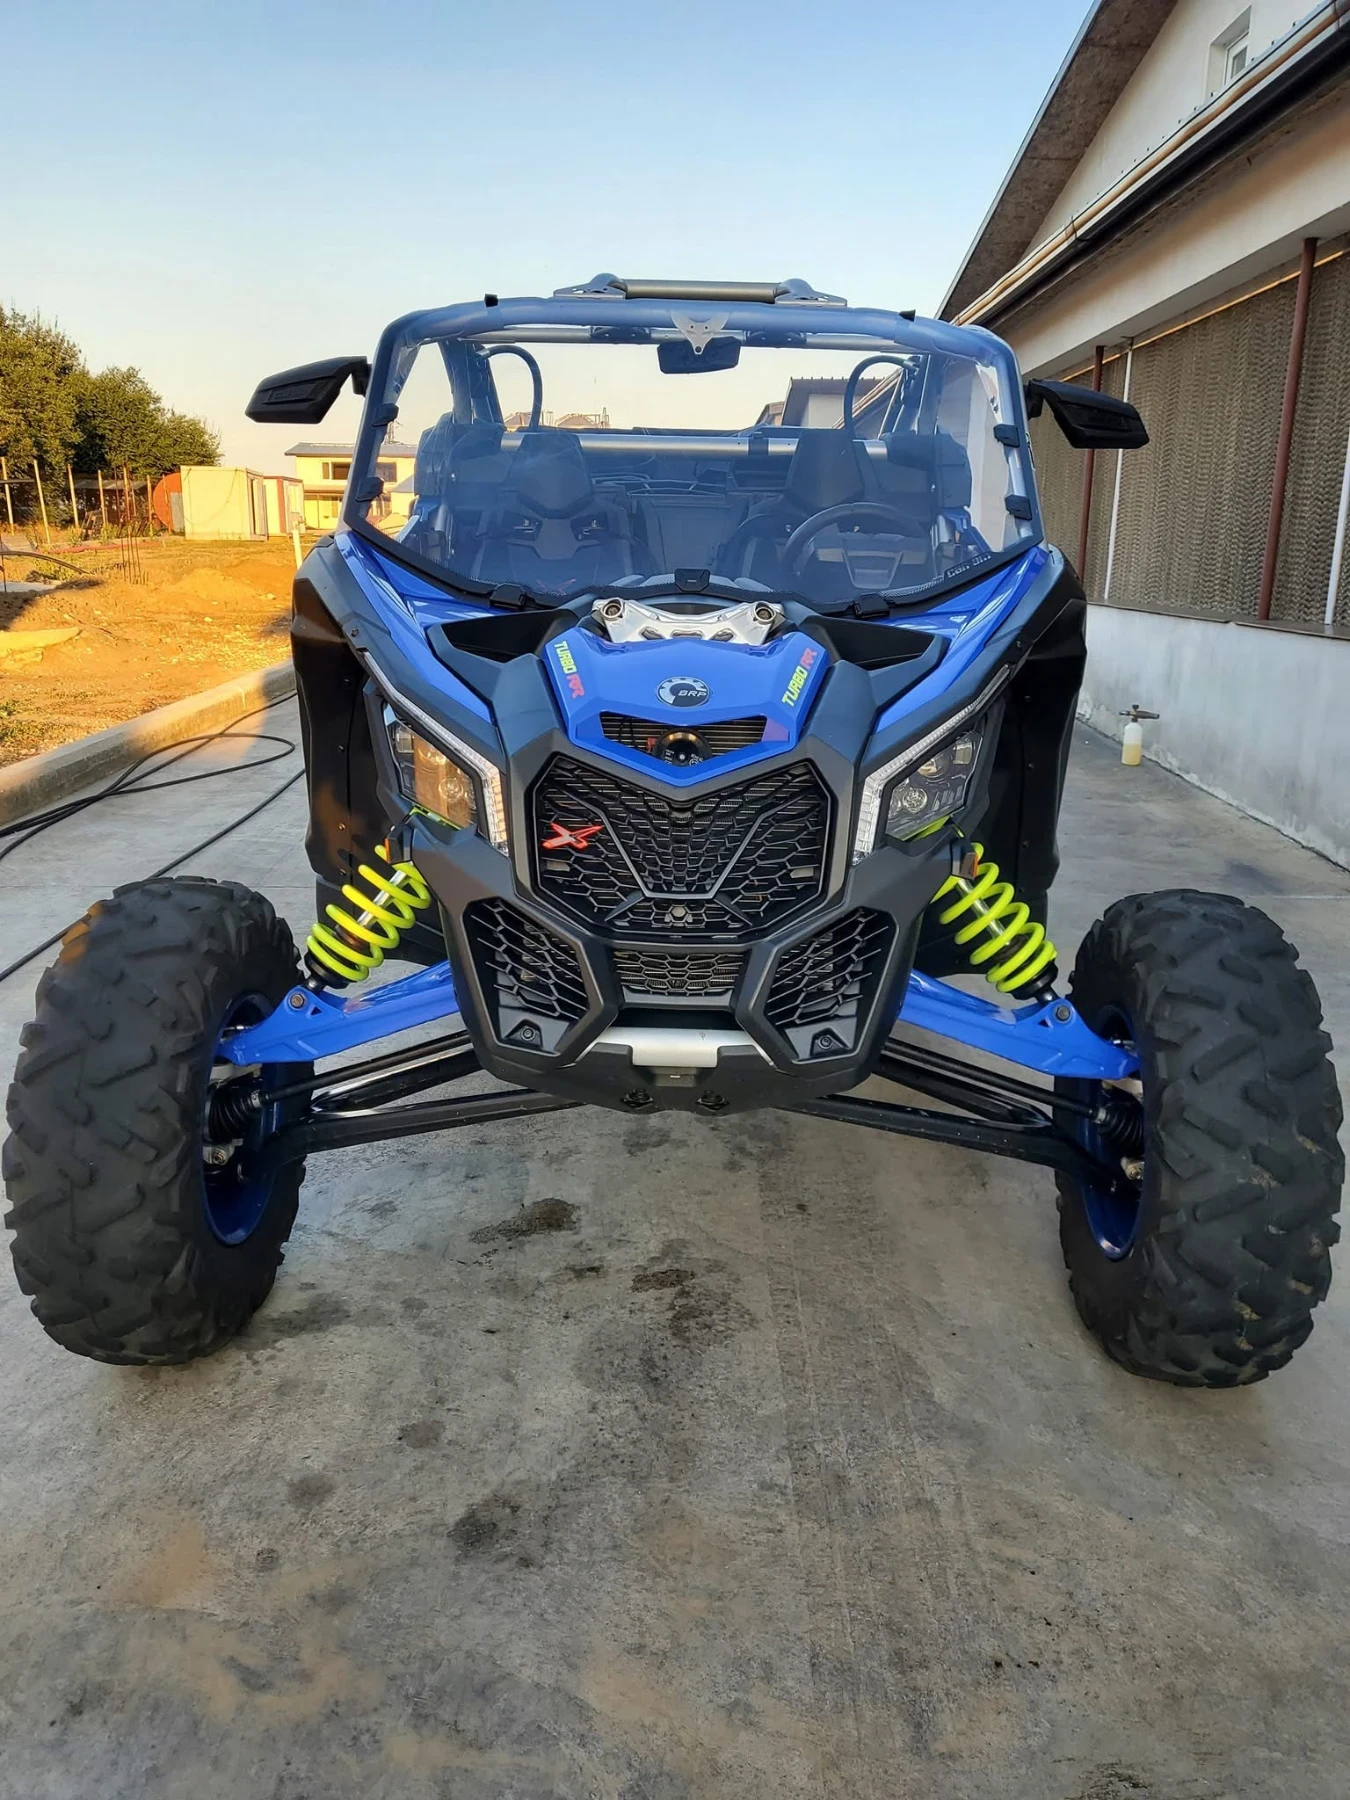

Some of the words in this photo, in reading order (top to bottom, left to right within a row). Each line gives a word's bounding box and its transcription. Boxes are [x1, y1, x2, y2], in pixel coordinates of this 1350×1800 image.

[554, 640, 578, 674] TURBO
[678, 689, 707, 697] BRP
[781, 665, 808, 707] TURBO
